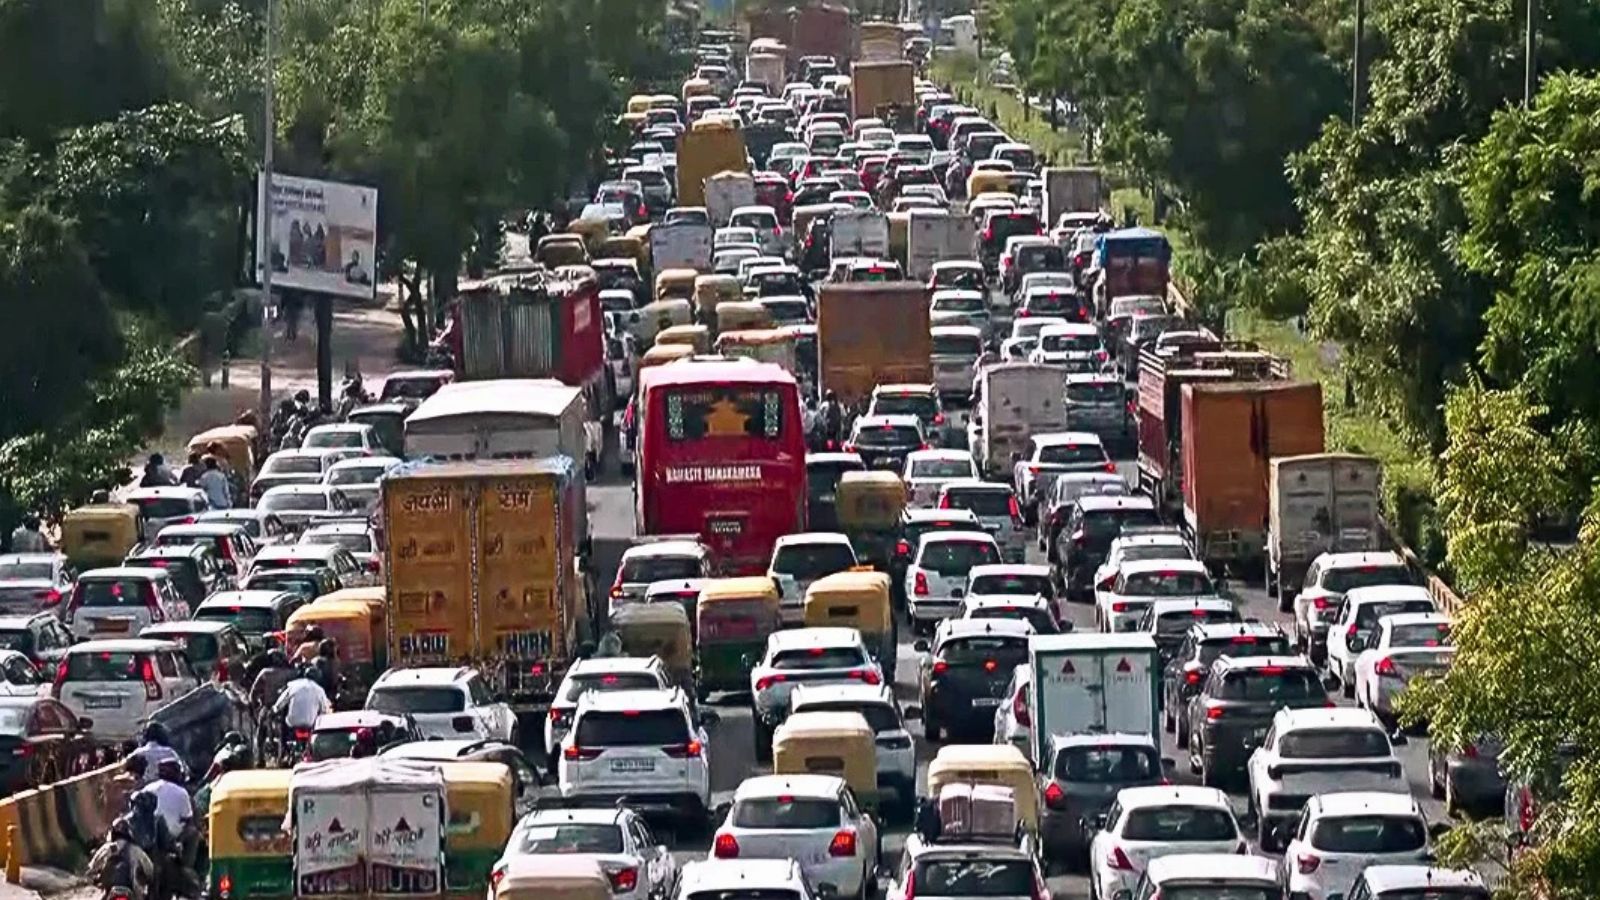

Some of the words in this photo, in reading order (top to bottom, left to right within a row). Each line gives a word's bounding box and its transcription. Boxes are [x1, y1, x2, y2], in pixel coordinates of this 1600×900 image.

[400, 633, 449, 653] BLOW
[303, 799, 315, 814] R
[422, 794, 433, 808] C
